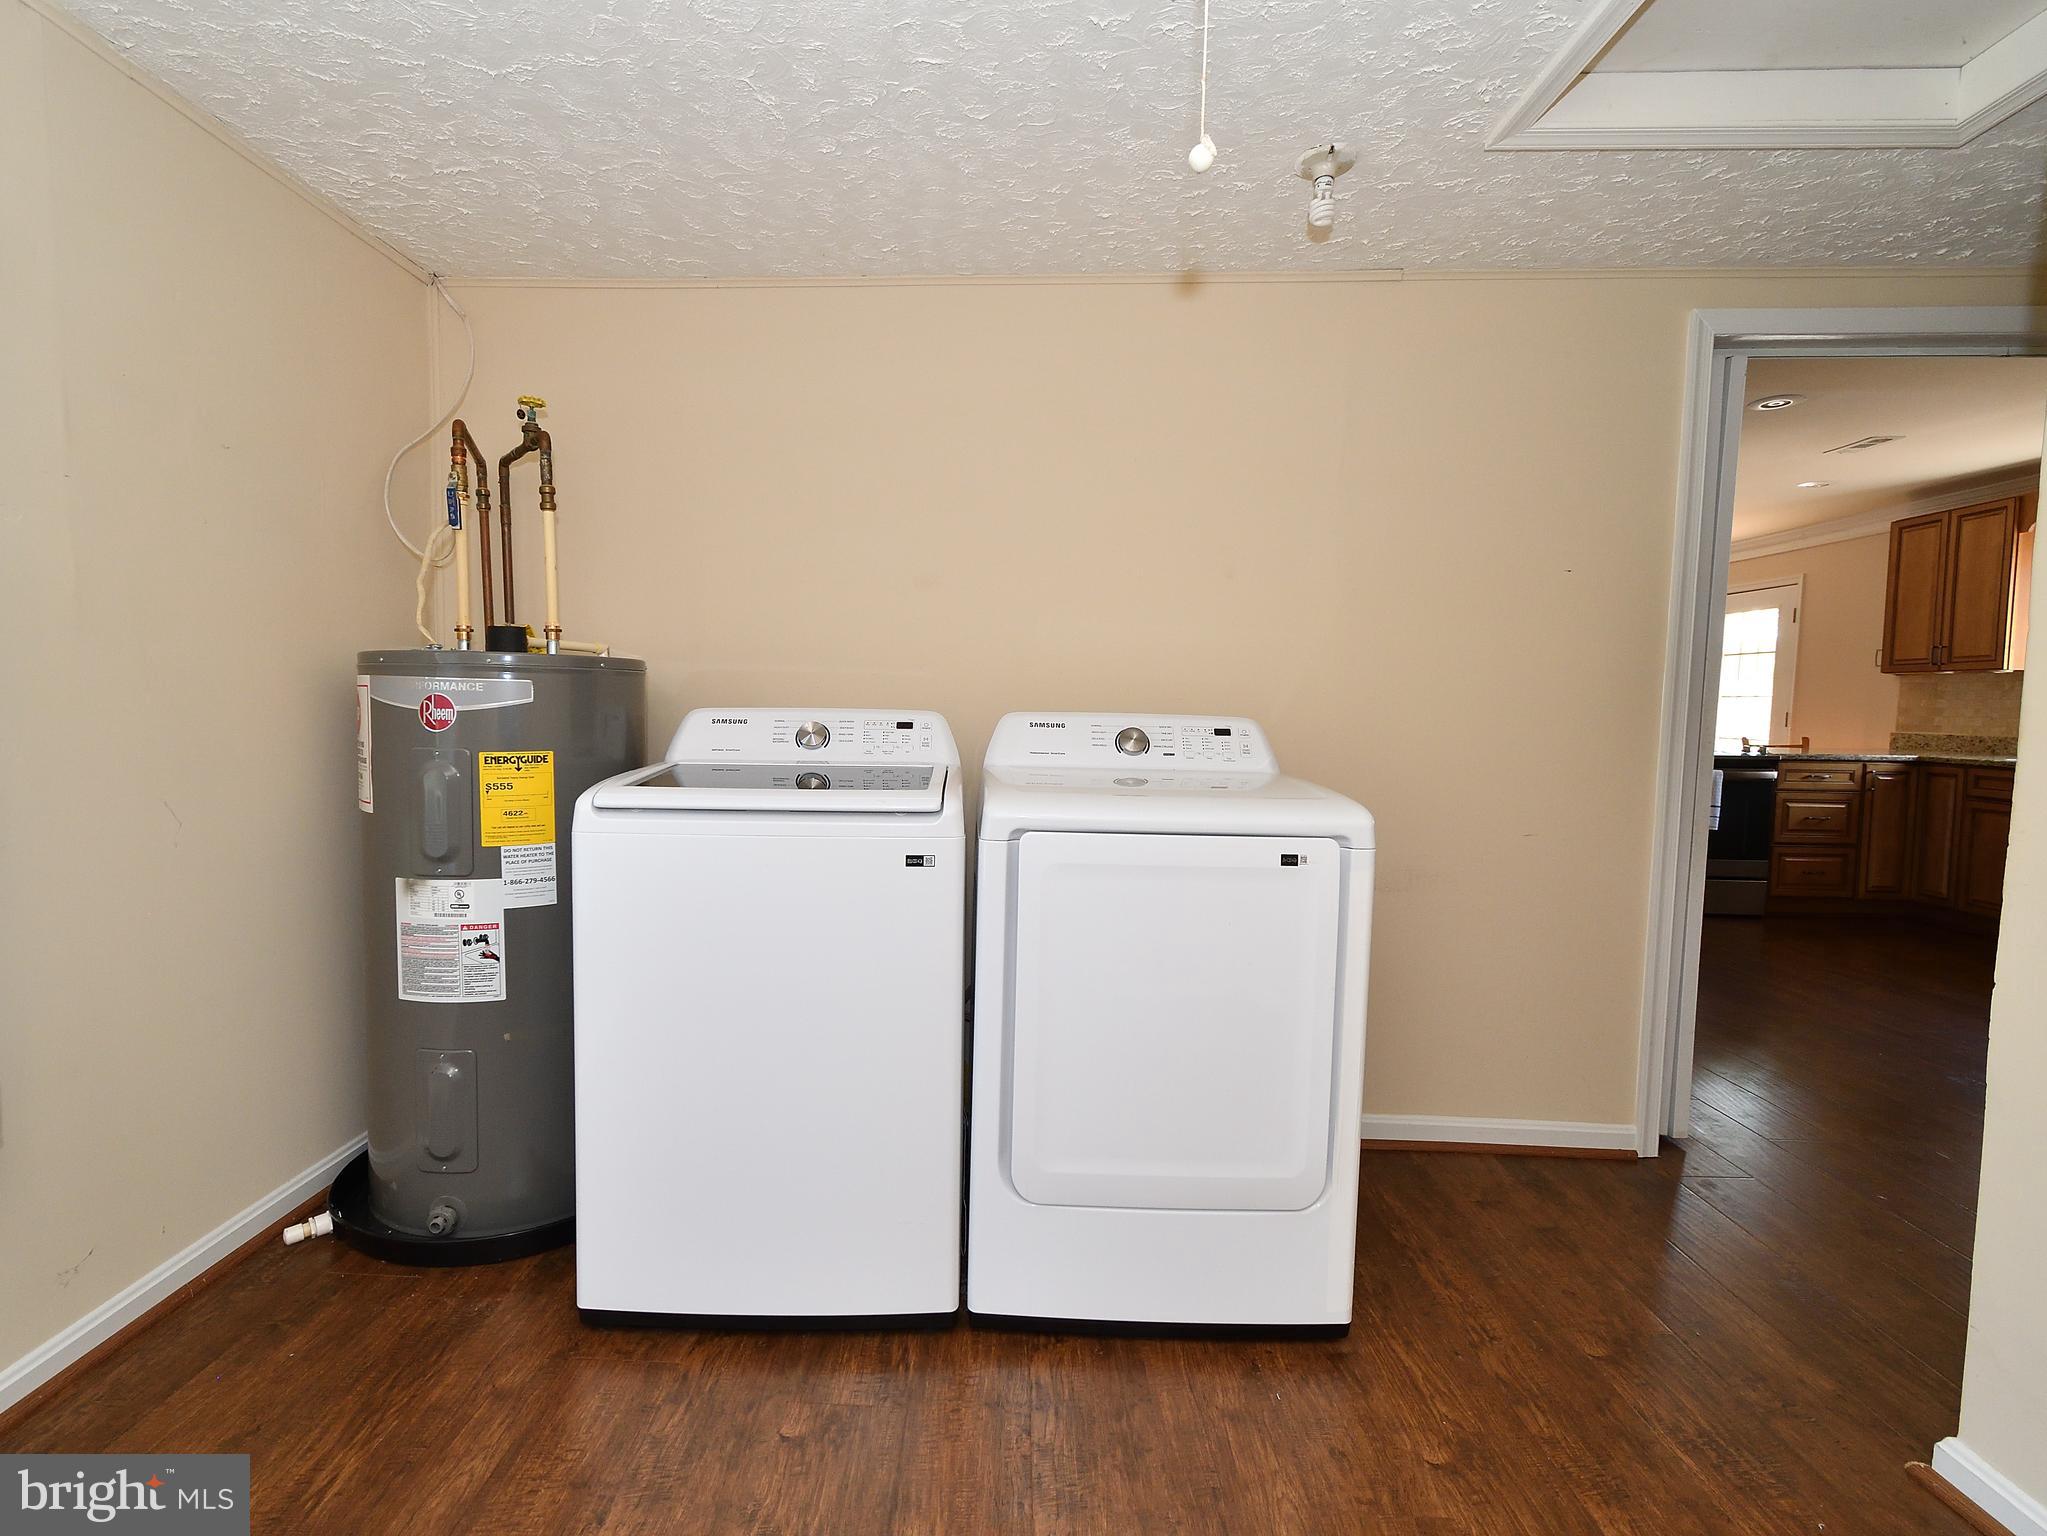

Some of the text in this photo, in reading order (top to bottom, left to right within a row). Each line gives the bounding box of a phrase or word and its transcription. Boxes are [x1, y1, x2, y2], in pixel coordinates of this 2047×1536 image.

[423, 694, 454, 725] Rheem
[1029, 721, 1066, 729] SAMSUNG
[484, 755, 549, 765] ENERGYGUIDE
[485, 782, 513, 790] $555
[503, 876, 556, 886] 1-866-279-4566
